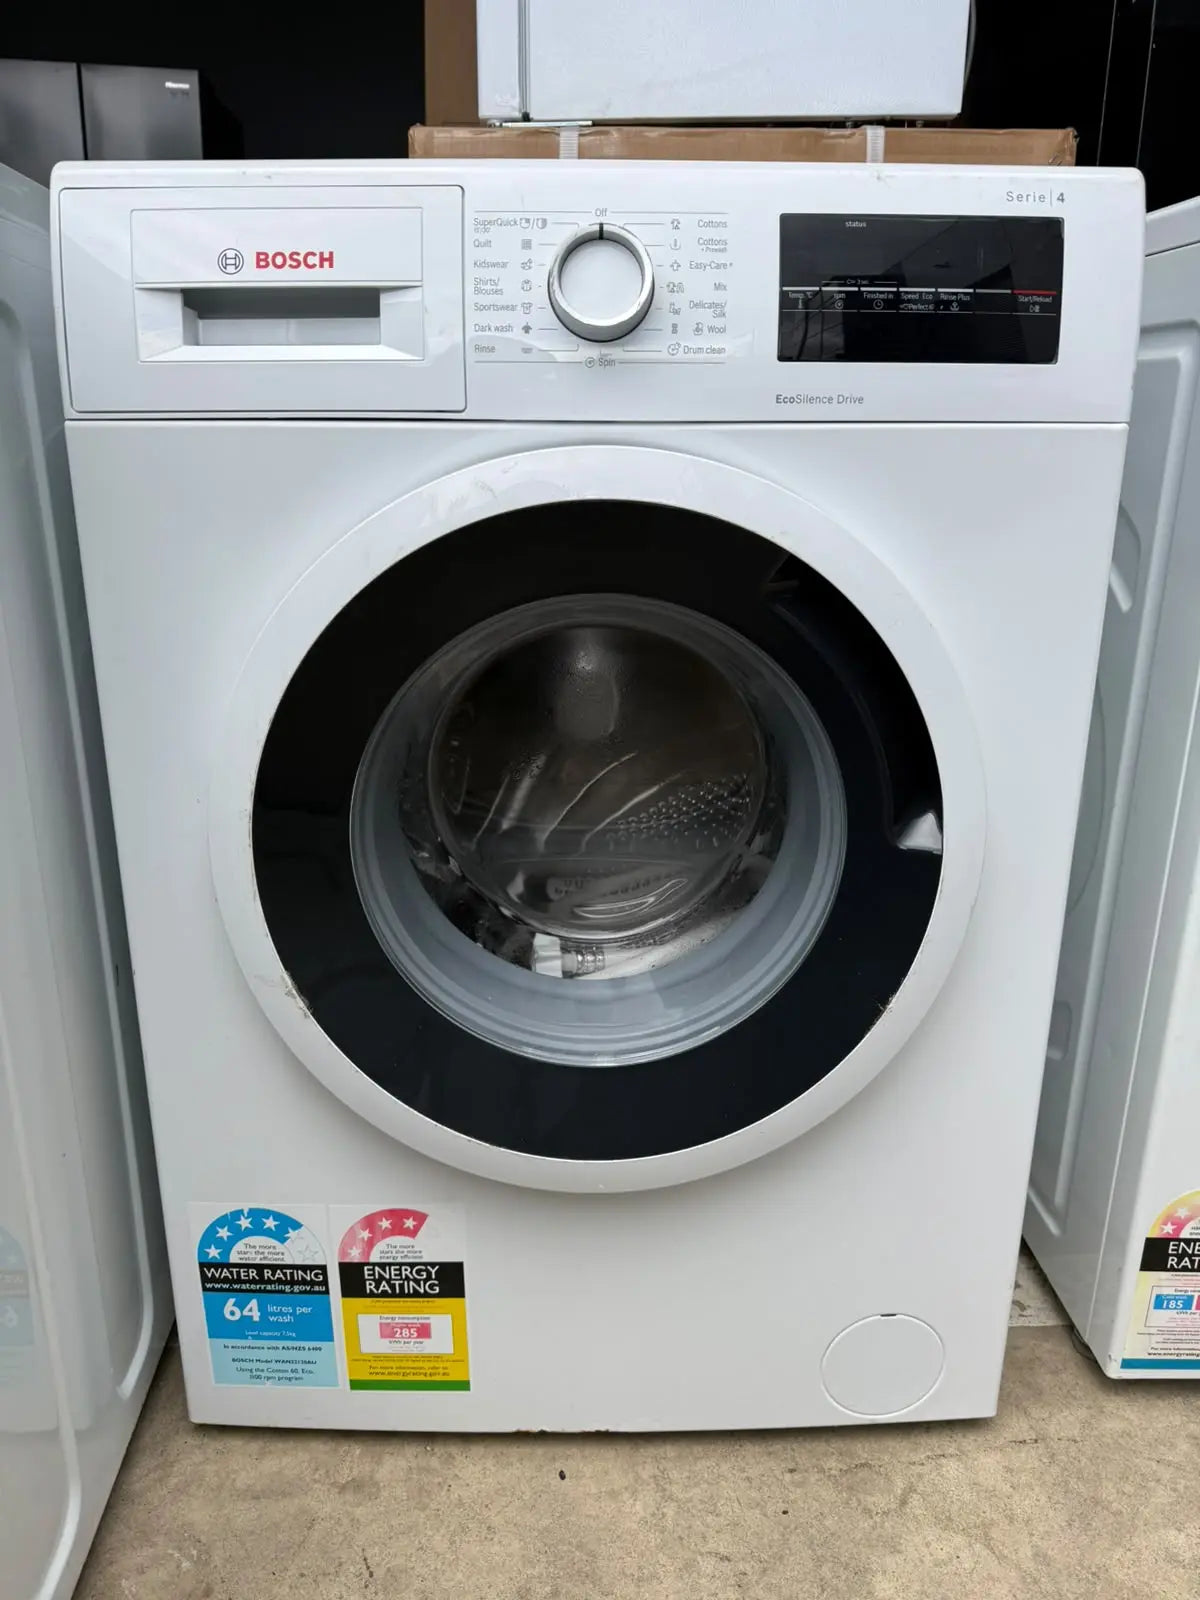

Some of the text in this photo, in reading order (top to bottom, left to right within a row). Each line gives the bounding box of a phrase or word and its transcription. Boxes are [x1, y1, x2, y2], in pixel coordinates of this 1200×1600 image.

[1006, 190, 1065, 203] Serie 4
[594, 208, 608, 217] Off
[473, 217, 519, 228] SuperQuick
[697, 219, 728, 228] Cottons
[845, 220, 867, 228] status
[473, 239, 492, 248] Quilt
[697, 237, 728, 247] Cottons
[255, 251, 335, 270] BOSCH
[473, 260, 509, 269] Kidswear
[689, 261, 728, 271] Easy-Care
[473, 277, 500, 286] Shirts/
[713, 282, 728, 291] Mix
[473, 286, 504, 296] Blouses
[901, 293, 920, 302] Speed
[473, 302, 518, 312] Sportswear
[689, 300, 727, 310] Delicates/
[712, 309, 727, 318] Silk
[473, 323, 514, 333] Dark wash
[706, 325, 727, 334] Wool
[474, 344, 496, 353] Rinse
[683, 345, 726, 354] Drum clean
[598, 358, 616, 367] Spin
[775, 394, 865, 405] EcoSilence Drive
[1167, 1256, 1200, 1269] RAT
[203, 1267, 323, 1282] WATER RATING
[363, 1265, 440, 1280] ENERGY
[204, 1282, 326, 1293] www.waterrating.gov.au
[366, 1280, 440, 1294] RATING
[223, 1297, 260, 1322] 64
[267, 1303, 313, 1315] litres per
[1162, 1300, 1184, 1309] 185
[268, 1314, 294, 1323] wash
[393, 1327, 418, 1338] 285
